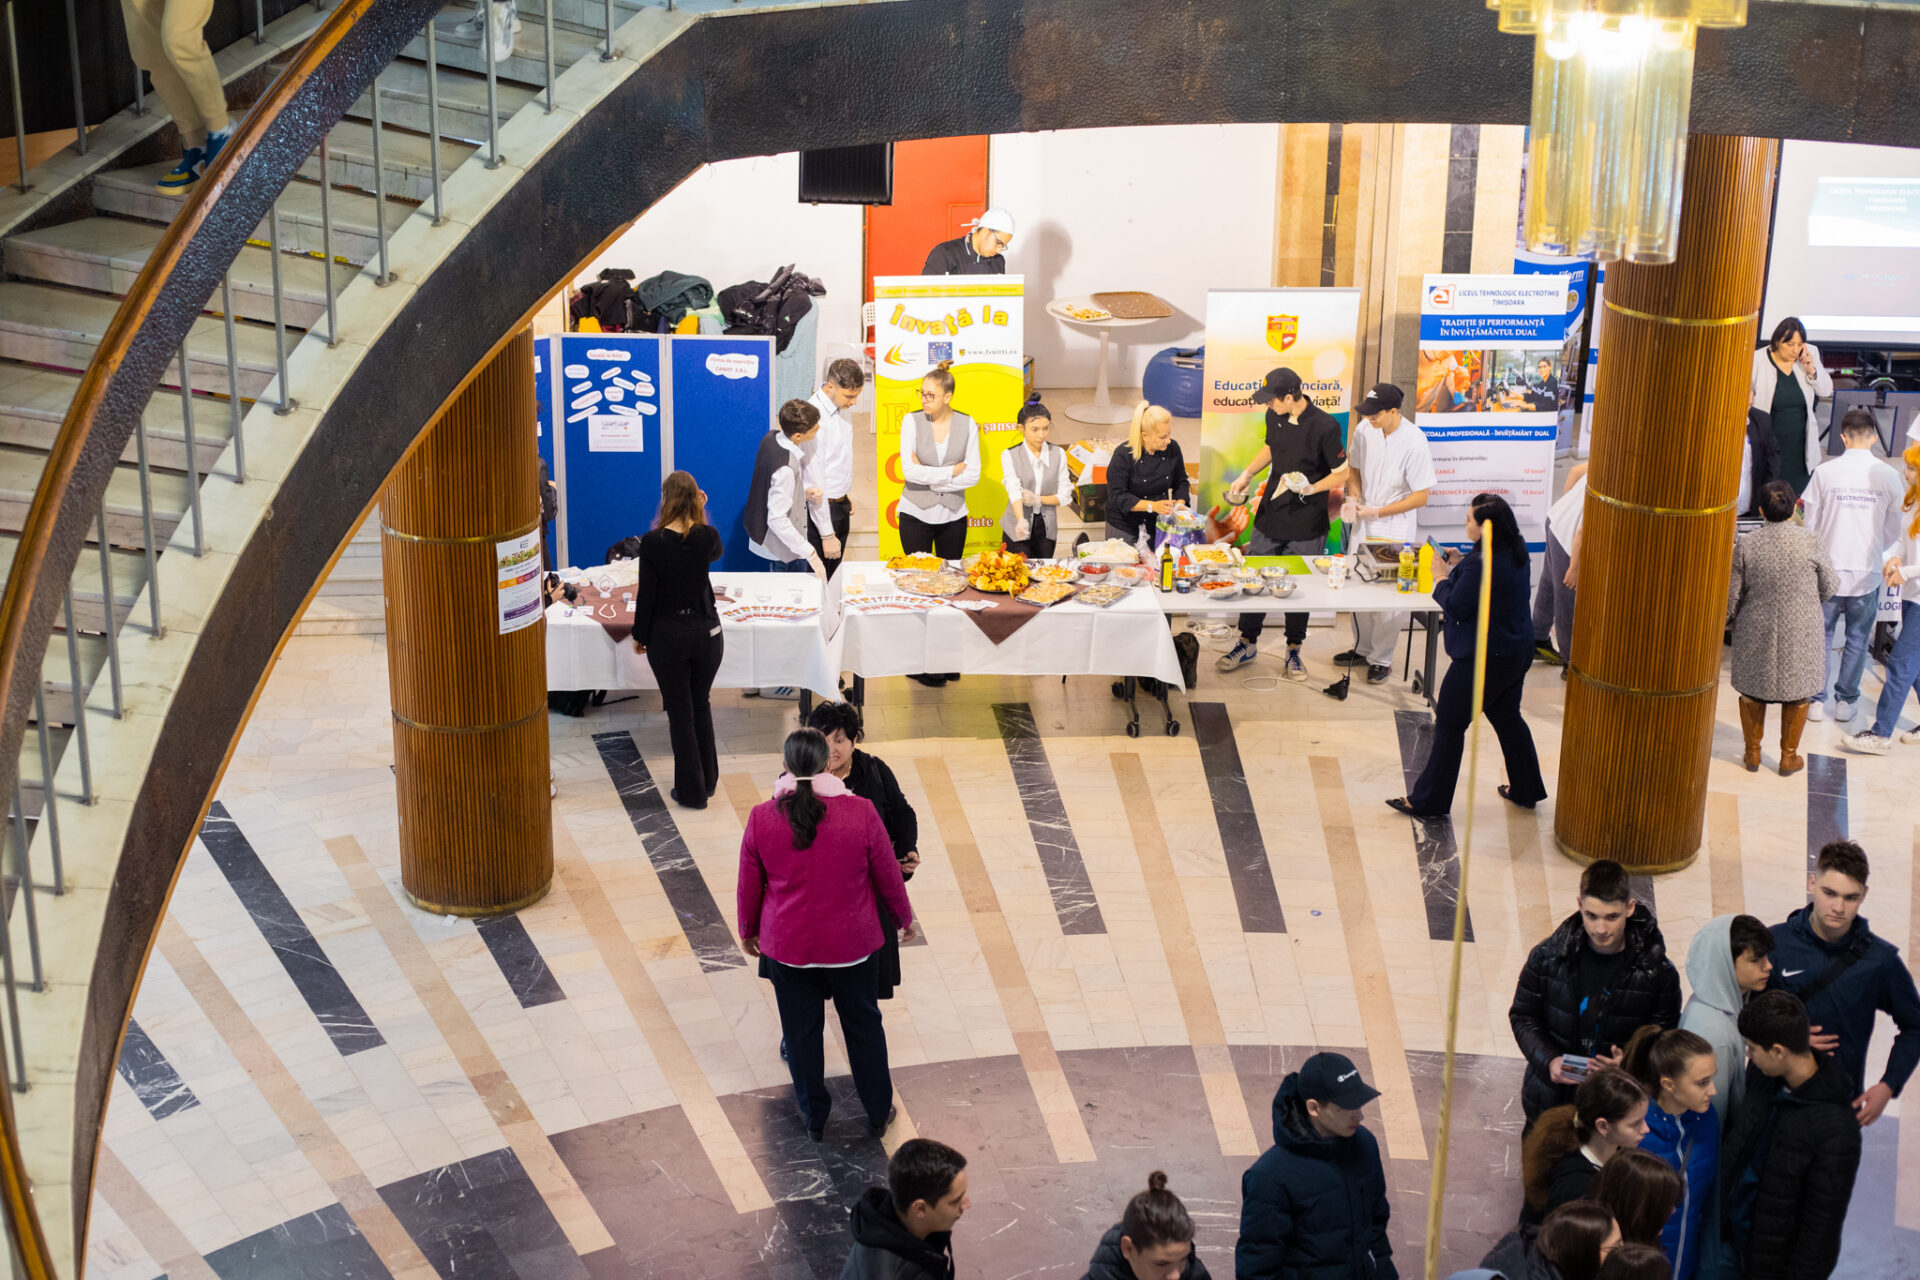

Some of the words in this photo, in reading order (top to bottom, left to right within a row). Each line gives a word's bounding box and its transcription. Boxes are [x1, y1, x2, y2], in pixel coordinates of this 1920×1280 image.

[982, 304, 1008, 326] la
[1440, 328, 1450, 336] ÎN
[1214, 380, 1263, 392] Educați
[1302, 380, 1343, 392] nciară,
[1213, 397, 1255, 408] educaț
[967, 516, 993, 528] tate
